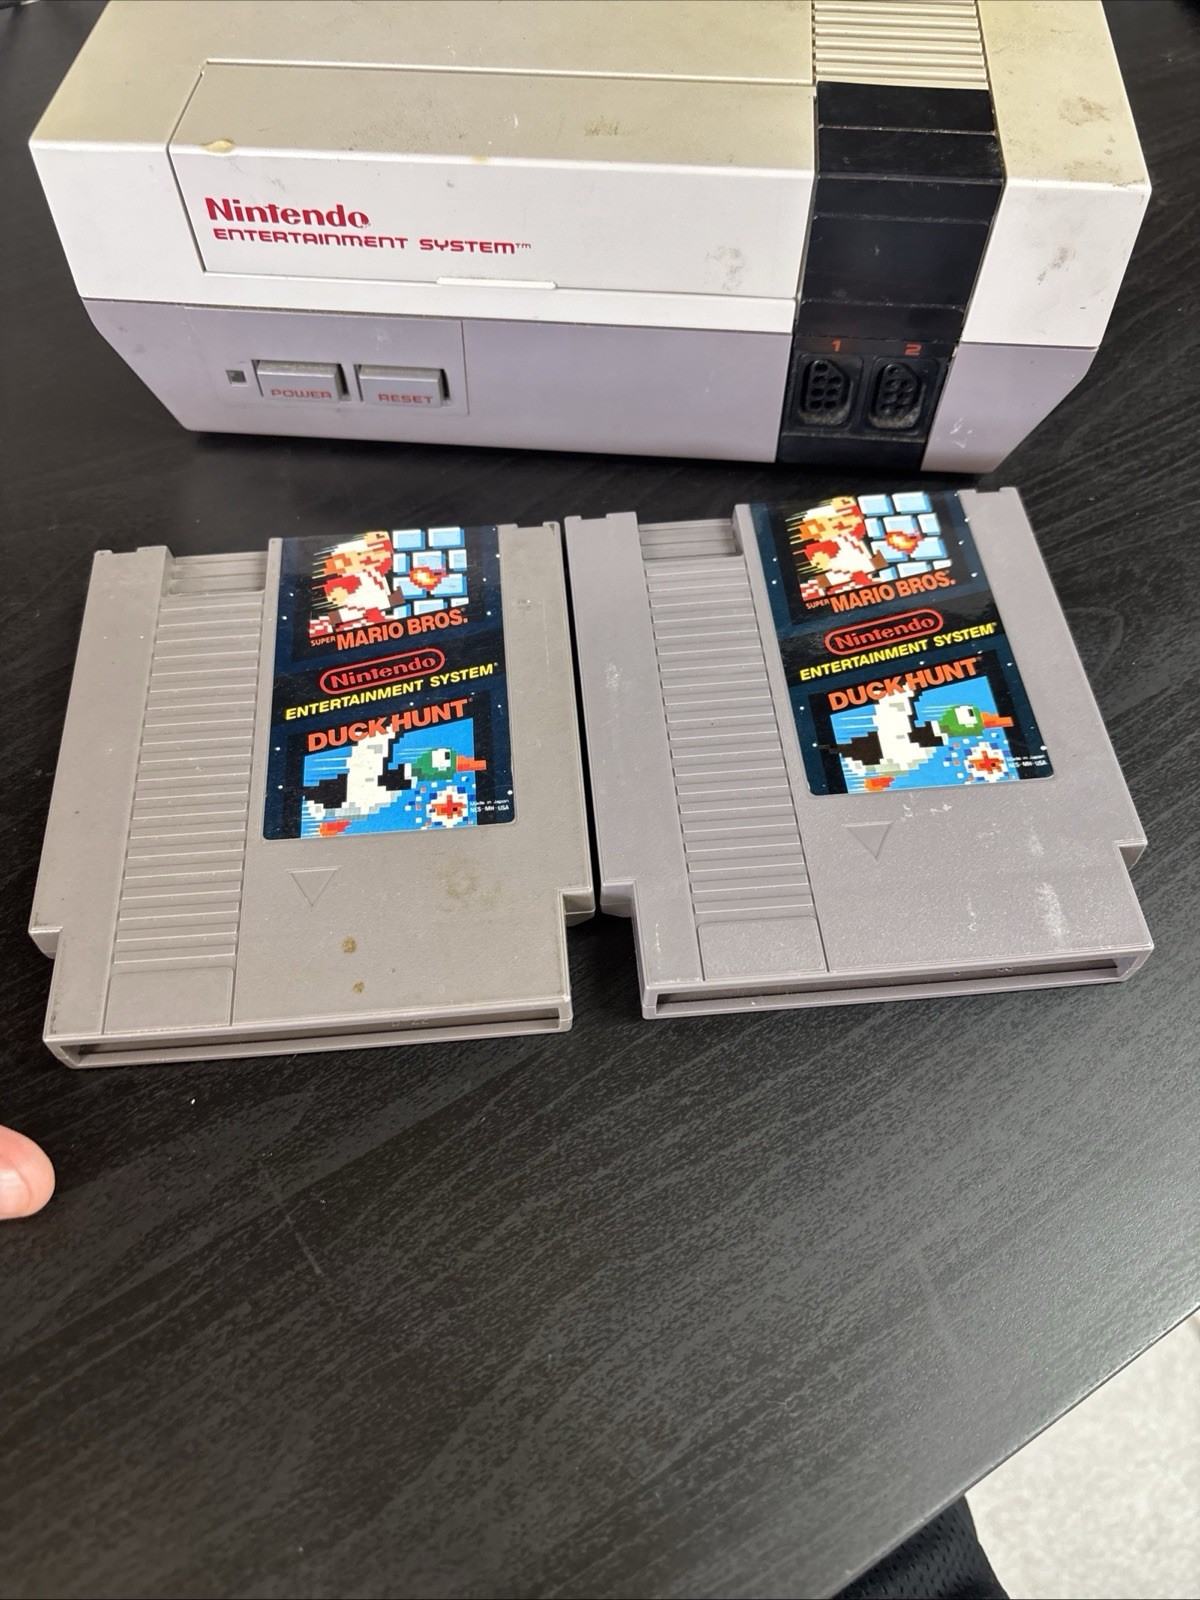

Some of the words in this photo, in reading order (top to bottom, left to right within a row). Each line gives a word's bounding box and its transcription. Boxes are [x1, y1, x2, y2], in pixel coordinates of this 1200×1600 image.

[205, 197, 369, 228] Nintendo
[213, 228, 408, 250] ENTERTAINMENT
[832, 340, 841, 353] 1
[904, 342, 921, 356] 2
[271, 388, 332, 400] POWER
[378, 393, 433, 405] RESET
[806, 597, 829, 610] SUPER
[830, 585, 895, 613] MARIO
[310, 636, 336, 647] SUPER
[337, 624, 404, 650] MARIO
[833, 618, 935, 650] Nintendo
[330, 656, 436, 689] Nintendo
[800, 639, 928, 681] ENTERTAINMENT
[827, 675, 903, 711] DUCK
[907, 659, 979, 688] HUNT
[285, 680, 424, 720] ENTERTAINMENT
[307, 716, 388, 752] DUCK
[394, 700, 470, 732] HUNT
